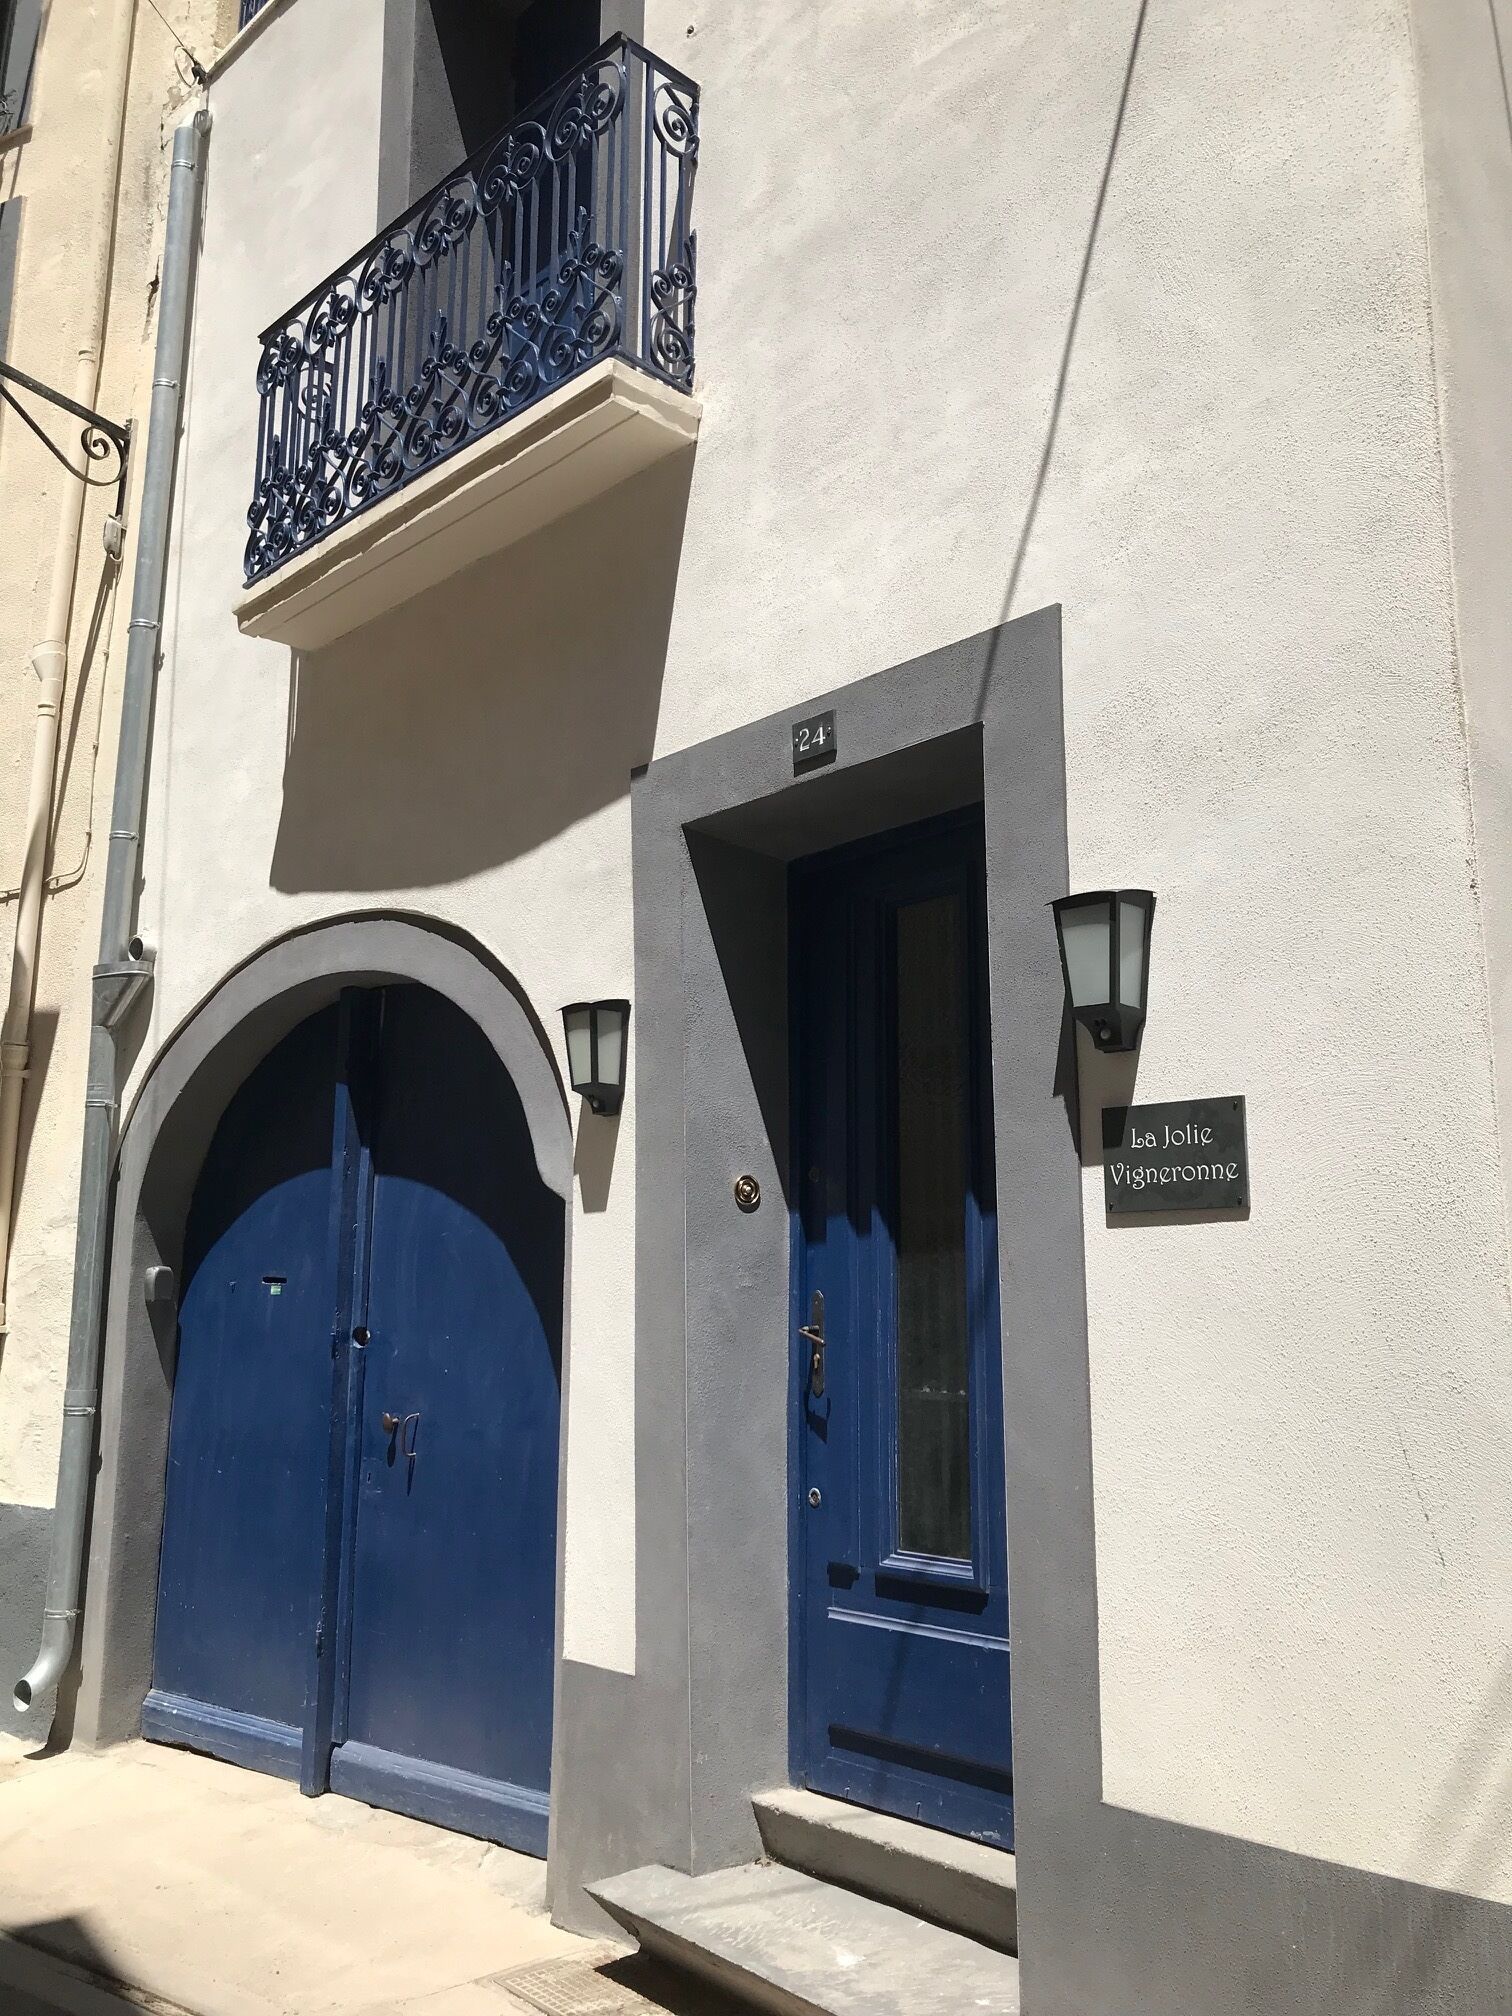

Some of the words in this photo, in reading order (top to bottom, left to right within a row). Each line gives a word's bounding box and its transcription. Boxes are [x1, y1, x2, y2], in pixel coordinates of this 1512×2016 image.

[799, 726, 826, 752] 24
[1130, 1128, 1157, 1149] La
[1162, 1123, 1213, 1149] Jolie
[1110, 1162, 1239, 1190] Vigneronne
